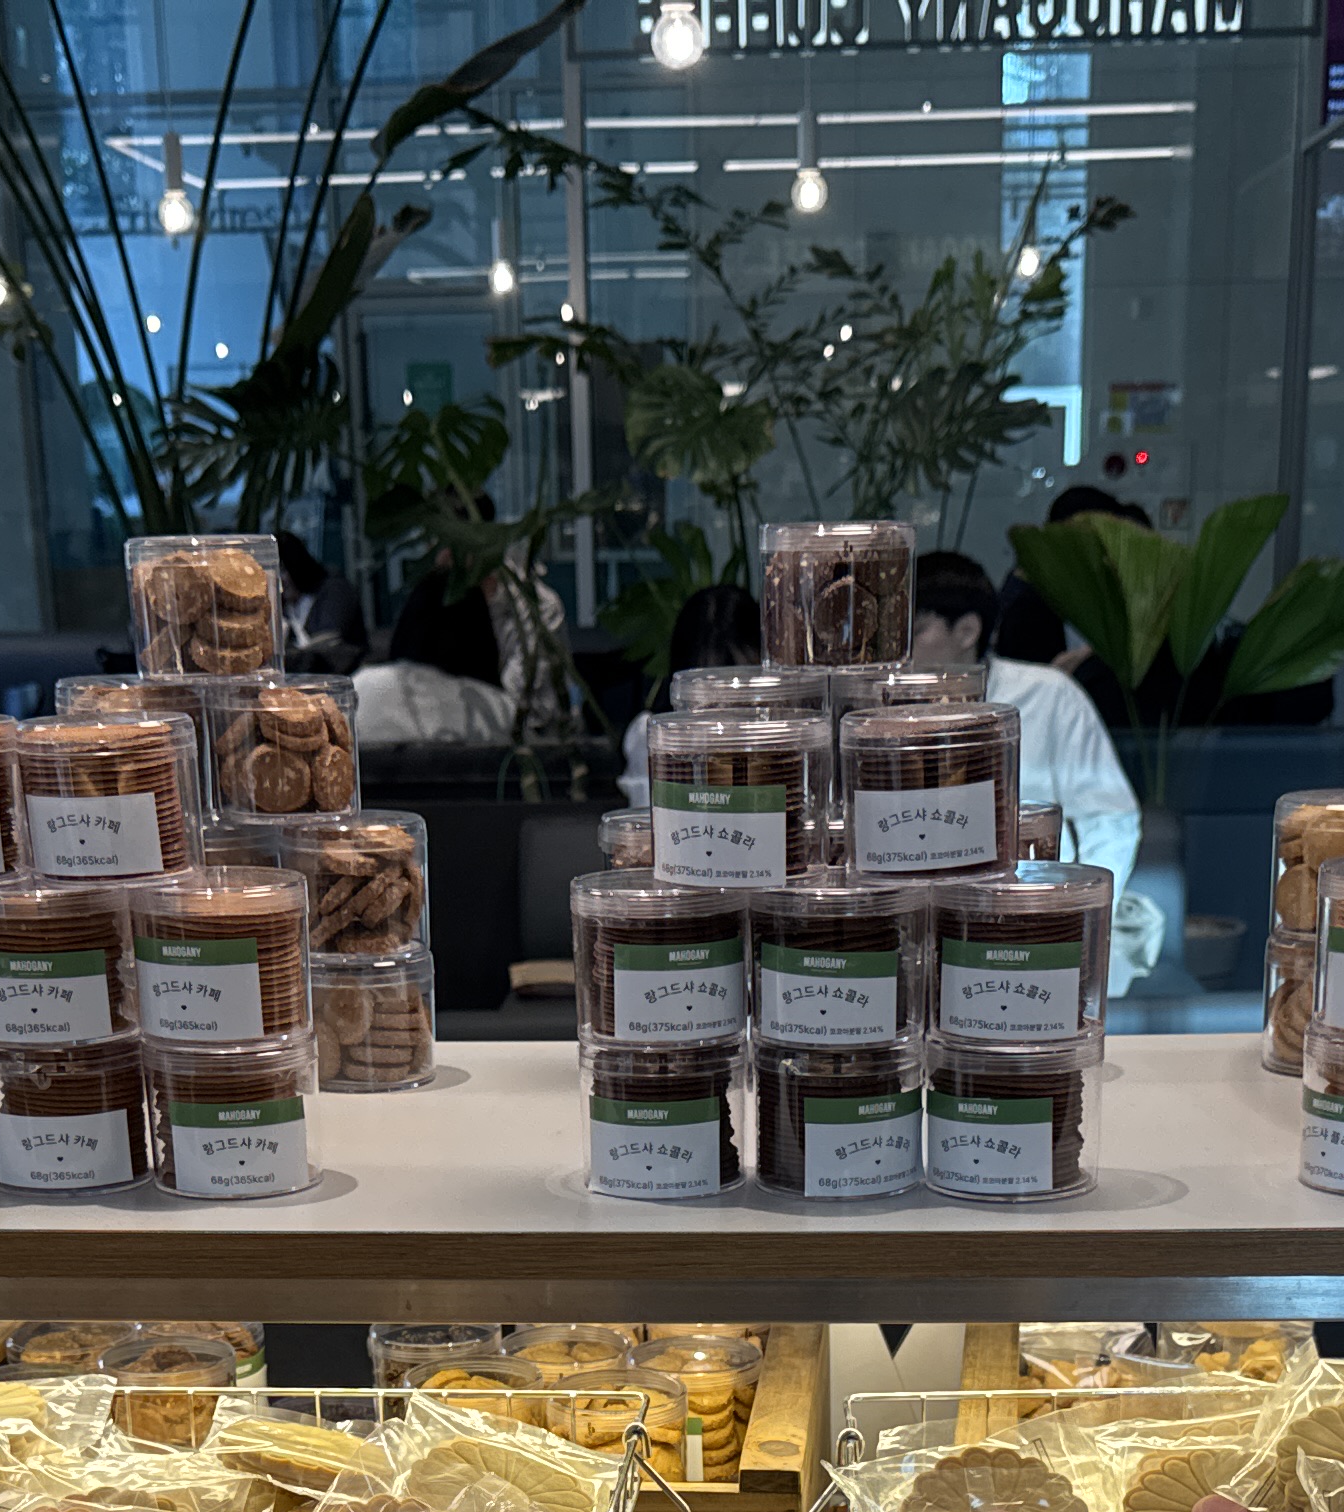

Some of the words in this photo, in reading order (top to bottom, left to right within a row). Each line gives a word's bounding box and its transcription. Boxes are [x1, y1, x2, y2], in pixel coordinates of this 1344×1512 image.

[47, 814, 90, 833] 랑그드샤
[95, 816, 121, 834] 카페
[878, 807, 927, 832] 랑그드샤
[930, 809, 968, 829] 쇼콜라
[670, 825, 714, 845] 랑그드샤
[717, 827, 756, 850] 쇼콜라
[47, 985, 73, 1003] 카페
[153, 981, 192, 997] 랑그드샤
[196, 984, 221, 1002] 카페
[644, 980, 694, 1004] 랑그드샤
[698, 982, 727, 1000] 쇼콜라
[782, 985, 828, 1004] 랑그드샤
[832, 987, 869, 1008] 쇼콜라
[962, 980, 1010, 999] 랑그드샤
[1013, 983, 1052, 1004] 쇼콜라
[21, 1133, 69, 1151] 랑그드샤
[74, 1135, 98, 1151] 카페
[202, 1136, 251, 1155] 랑그드샤
[255, 1138, 278, 1154] 카페
[609, 1142, 653, 1161] 랑그드샤
[657, 1144, 693, 1163] 쇼콜라
[835, 1136, 883, 1160] 랑그드샤
[885, 1136, 910, 1152] 쇼콜라
[941, 1135, 981, 1152] 랑그드샤
[984, 1137, 1021, 1159] 쇼콜라
